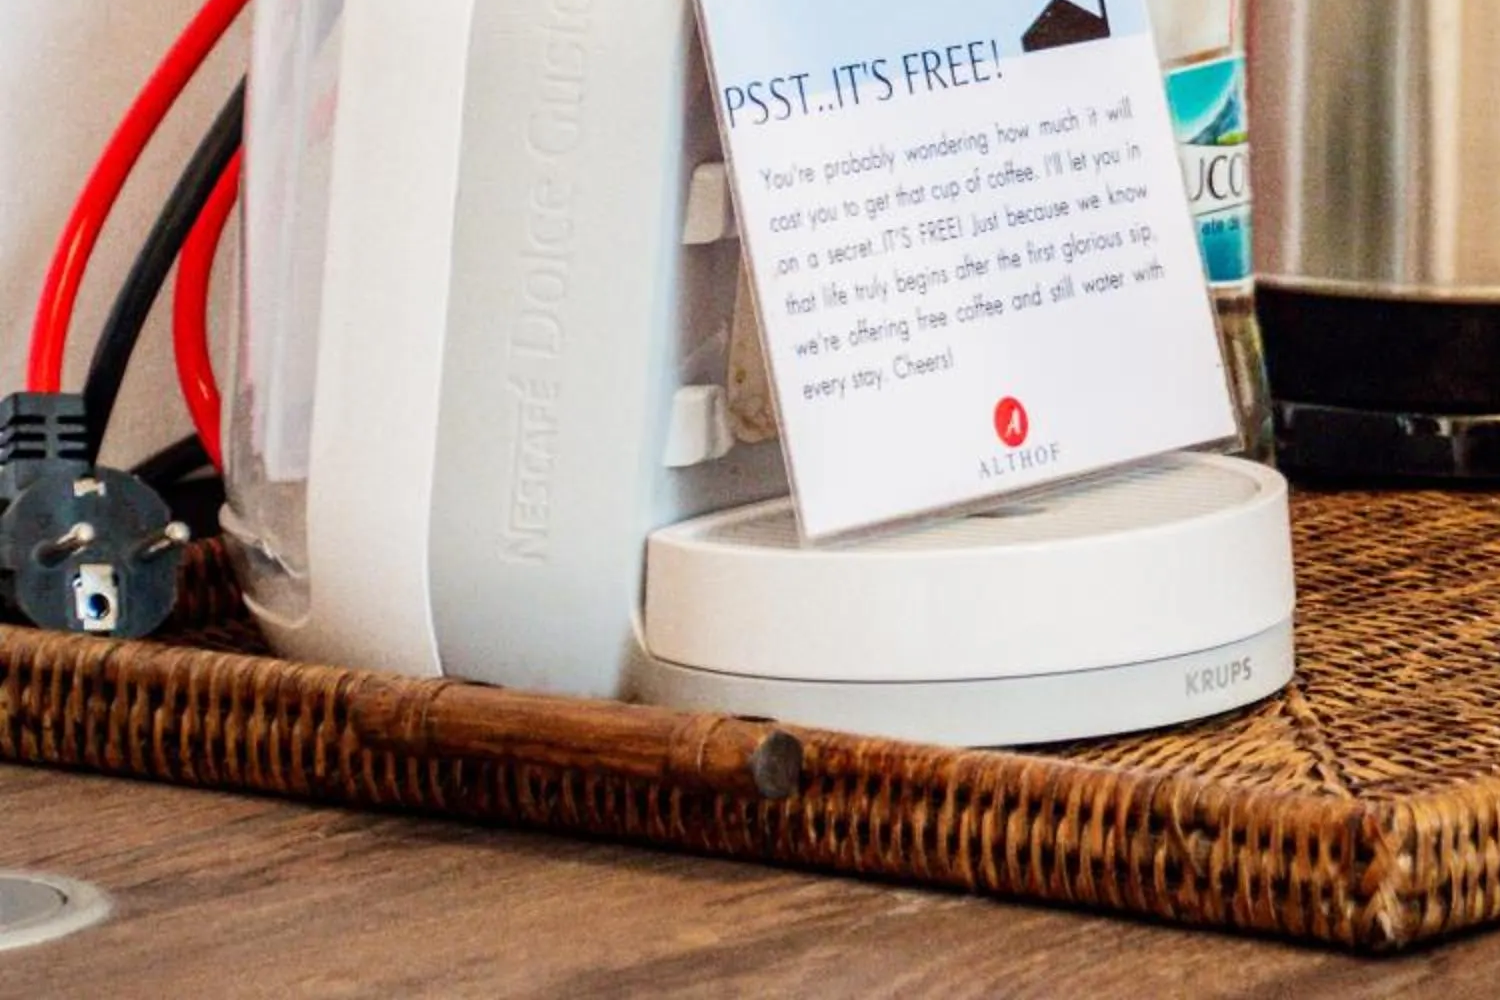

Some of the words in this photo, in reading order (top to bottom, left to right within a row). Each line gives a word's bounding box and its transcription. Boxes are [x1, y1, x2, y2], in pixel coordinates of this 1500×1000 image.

[901, 39, 1003, 96] FREE!
[759, 164, 815, 191] You're
[824, 144, 895, 185] probably
[903, 130, 988, 162] wondering
[994, 121, 1029, 143] how
[1039, 107, 1079, 135] much
[1106, 95, 1132, 121] will
[807, 205, 837, 231] you
[843, 199, 860, 218] to
[865, 193, 890, 221] get
[896, 183, 925, 206] that
[931, 180, 960, 202] cup
[965, 167, 981, 194] of
[1067, 148, 1087, 172] let
[1092, 150, 1120, 176] you
[1125, 141, 1141, 162] in
[777, 256, 799, 275] on
[807, 252, 819, 269] a
[1004, 200, 1069, 228] because
[1076, 193, 1101, 212] we
[1105, 182, 1147, 205] know
[785, 290, 816, 315] that
[855, 273, 888, 302] truly
[894, 266, 948, 296] begins
[955, 250, 988, 281] after
[997, 246, 1021, 270] the
[1026, 239, 1055, 265] first
[1060, 231, 1123, 264] glorious
[795, 328, 840, 356] we're
[848, 317, 910, 346] offering
[916, 305, 948, 331] free
[956, 291, 1003, 324] coffee
[1011, 280, 1042, 311] and
[1050, 272, 1075, 304] still
[1082, 271, 1124, 295] water
[1132, 254, 1165, 282] with
[802, 376, 846, 401] every
[977, 442, 1060, 480] ALTHOF
[1185, 656, 1251, 697] KRUPS
